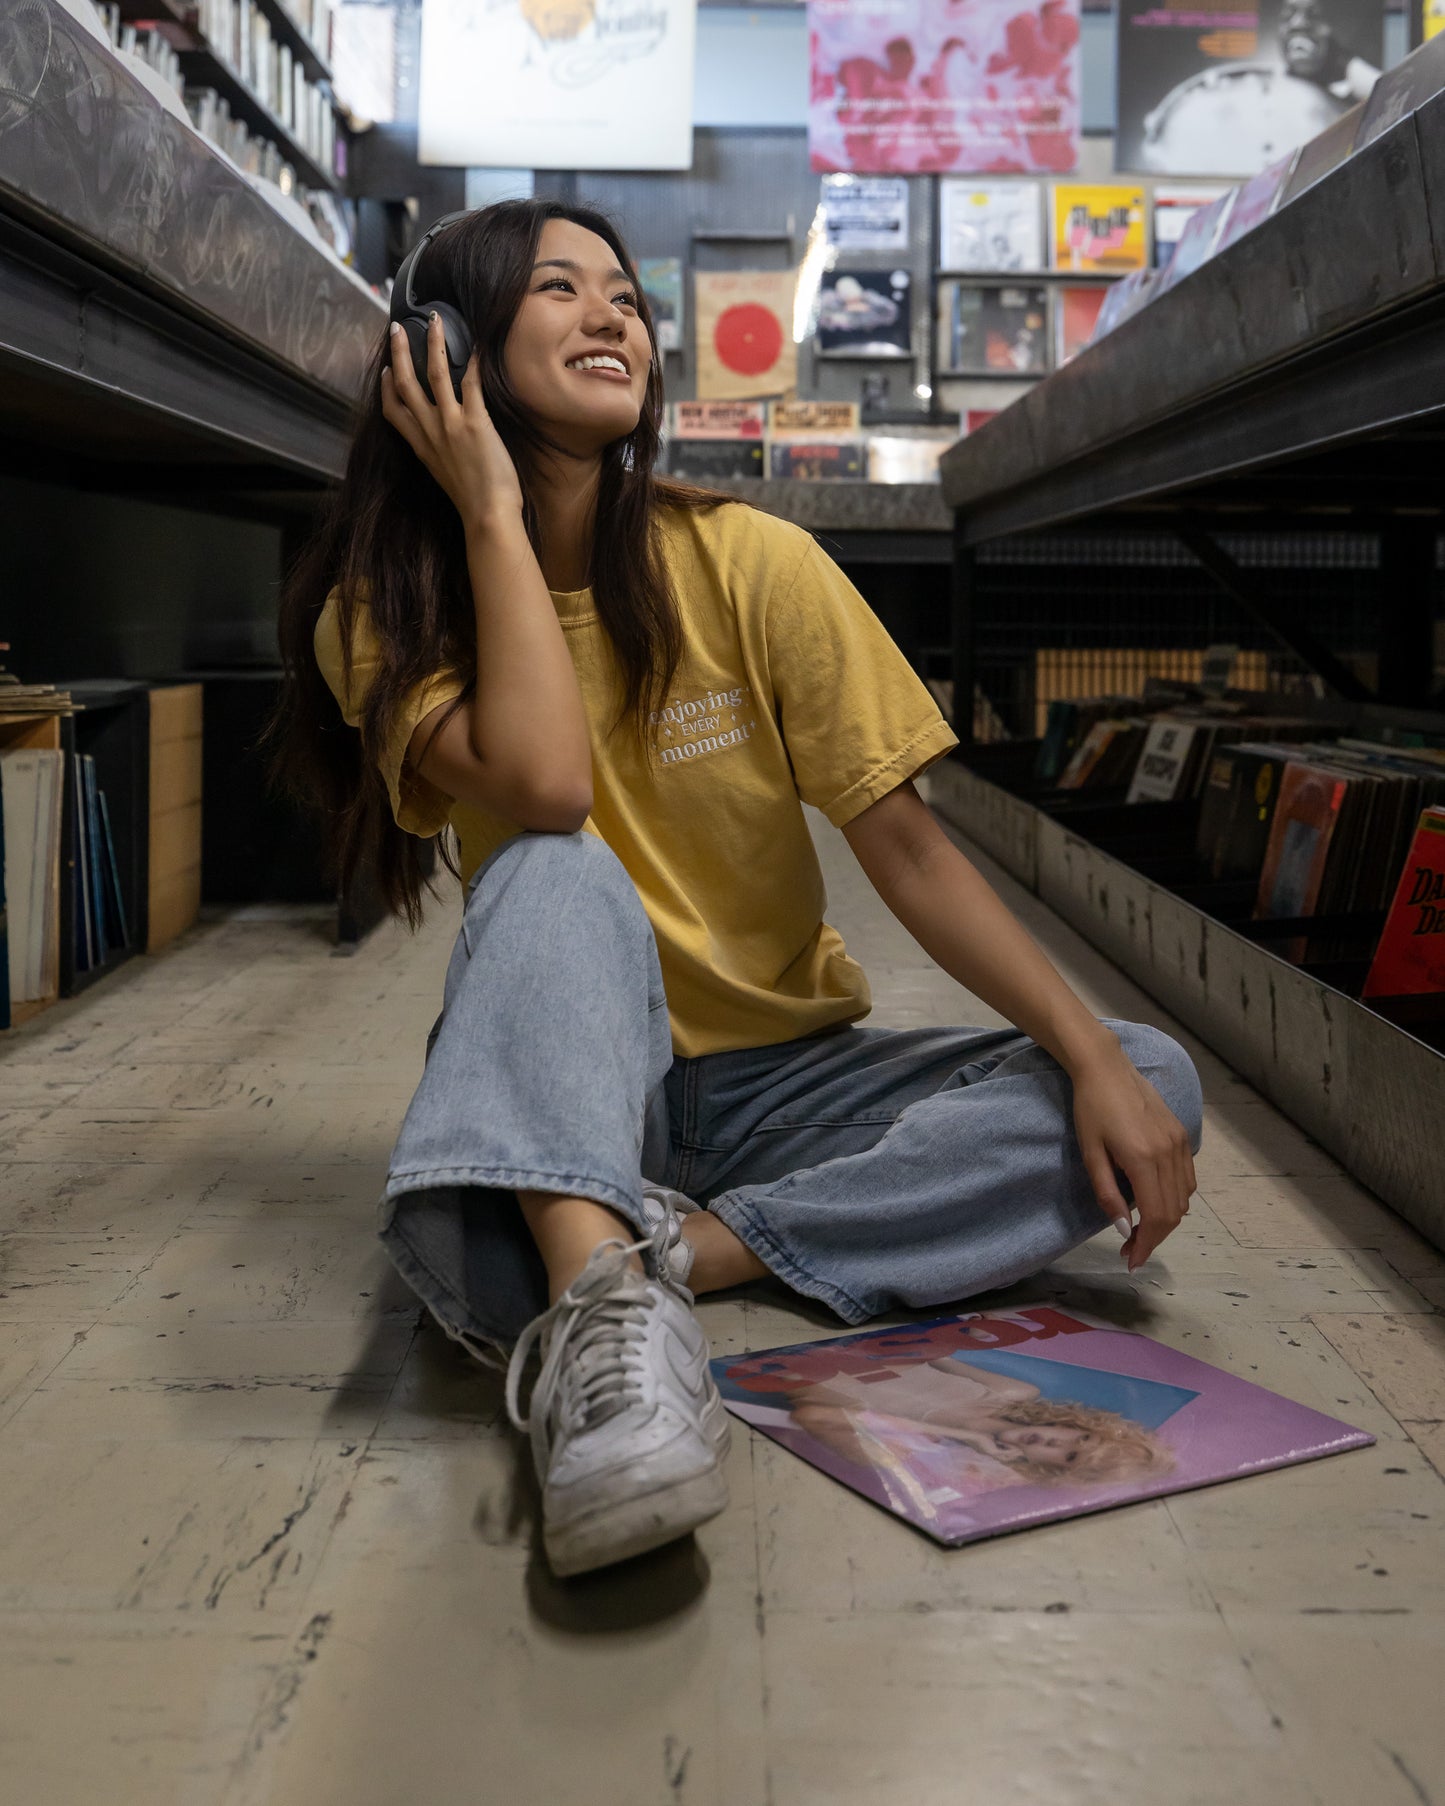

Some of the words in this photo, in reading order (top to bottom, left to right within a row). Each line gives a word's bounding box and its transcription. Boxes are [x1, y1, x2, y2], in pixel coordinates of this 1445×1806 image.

[649, 687, 742, 724] enjoying
[660, 723, 751, 763] moment
[681, 714, 721, 737] EVERY
